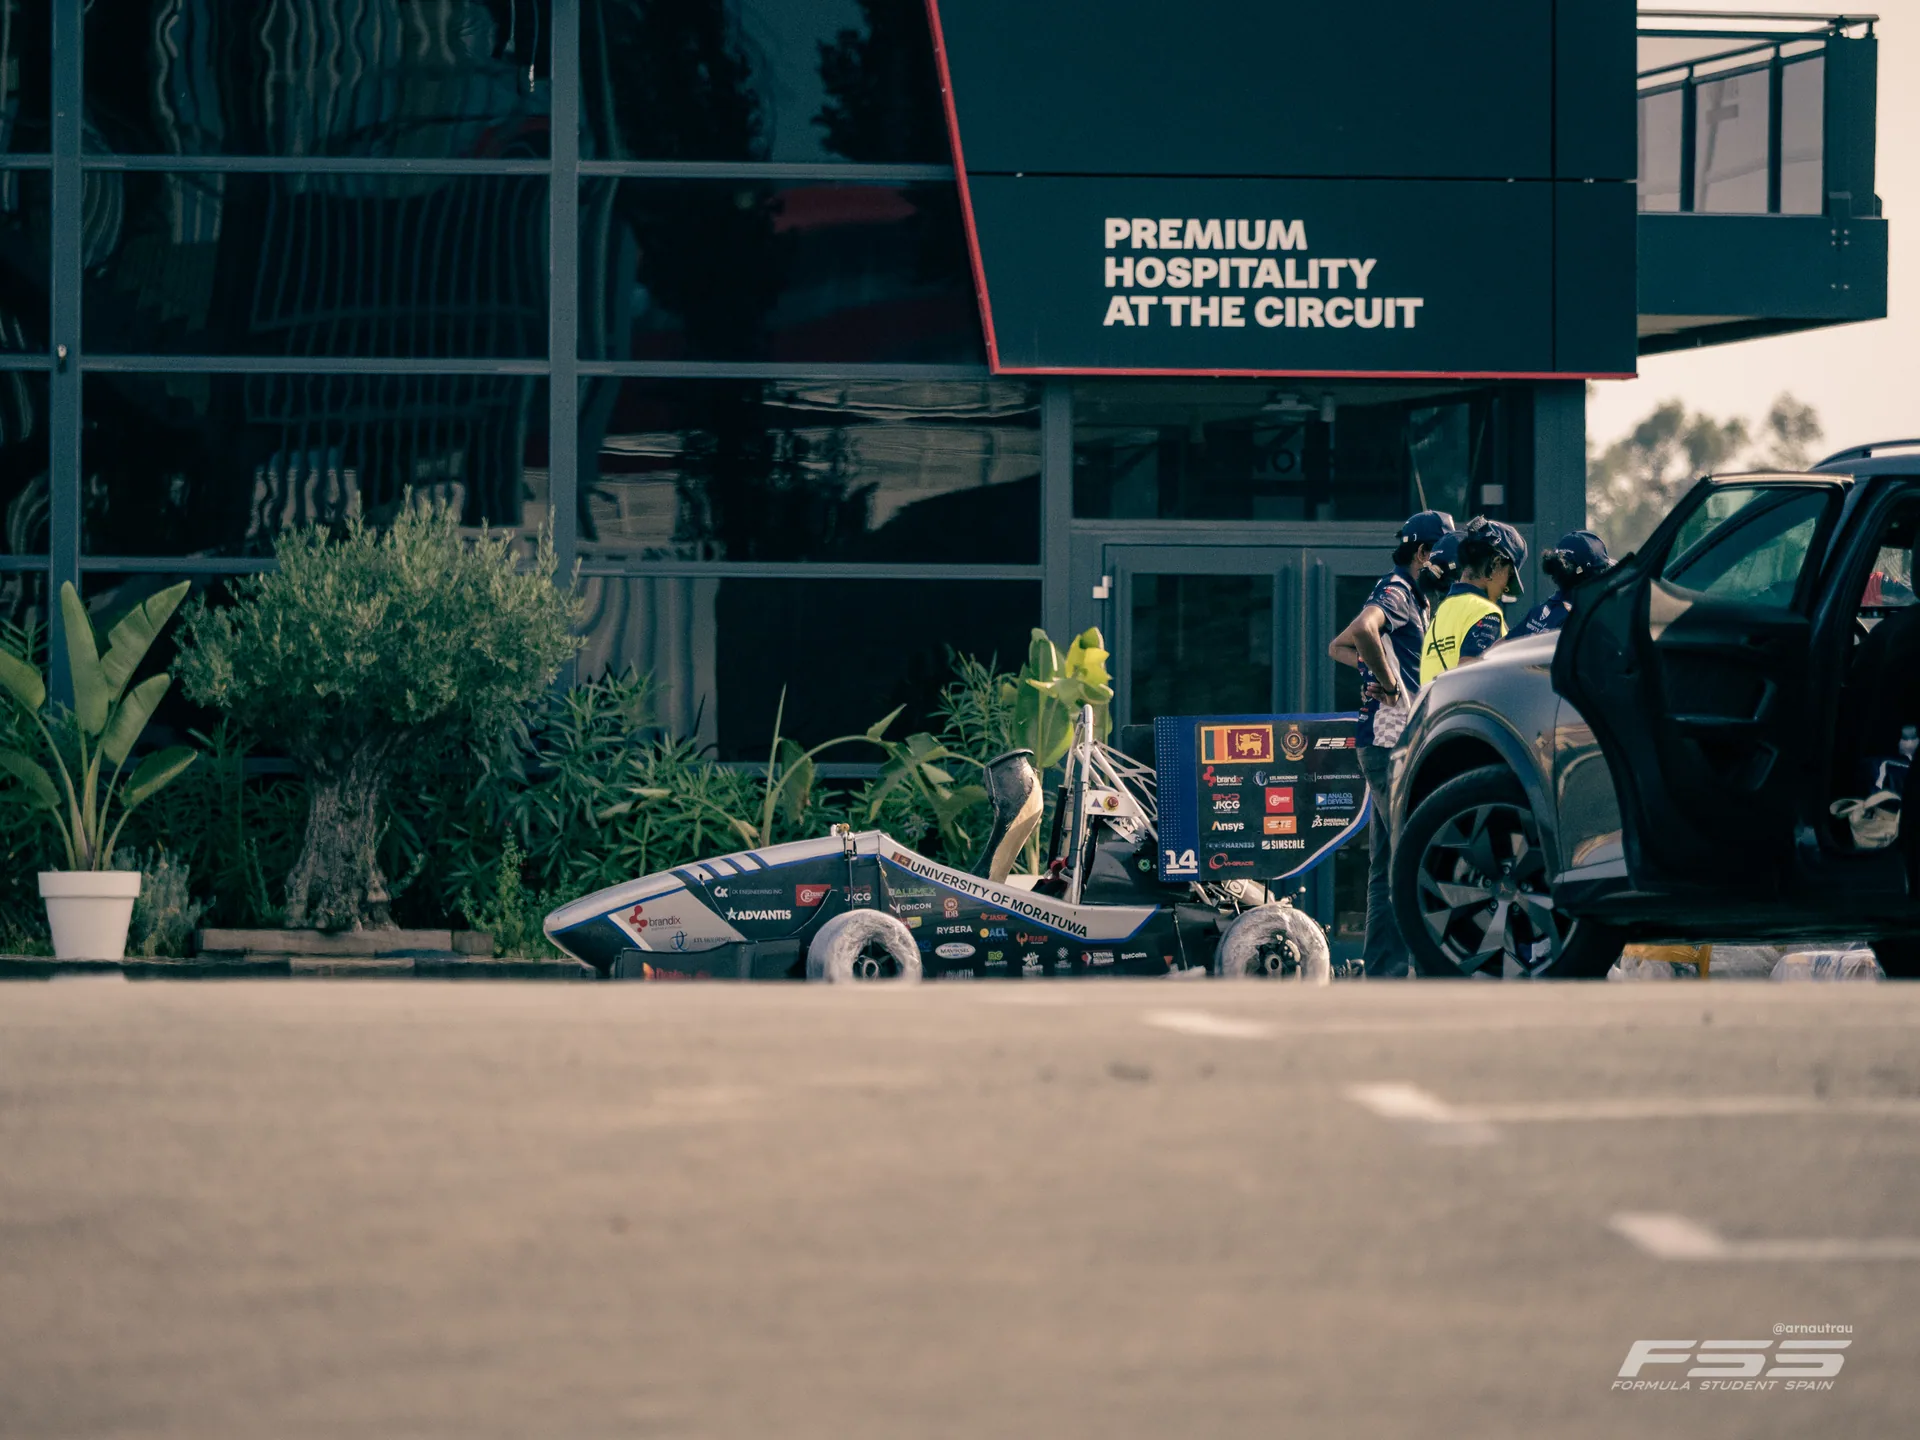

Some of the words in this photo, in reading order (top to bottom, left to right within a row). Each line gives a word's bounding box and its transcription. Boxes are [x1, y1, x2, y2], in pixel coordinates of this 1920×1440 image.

[1104, 218, 1308, 250] PREMIUM
[1104, 256, 1377, 289] HOSPITALITY
[1103, 296, 1158, 326] AT
[1162, 296, 1246, 327] THE
[1254, 297, 1424, 328] CIRCUIT
[1213, 801, 1240, 810] JKCG
[1211, 821, 1245, 832] Ansys
[1271, 840, 1305, 849] SIMSCALE
[1165, 850, 1198, 868] 14
[895, 887, 936, 896] ALUMEX
[844, 893, 872, 902] JKCG
[910, 861, 990, 898] UNIVERSITY
[990, 892, 1011, 906] OF
[1010, 898, 1087, 937] MORATUWA
[737, 909, 792, 921] ADVANTIS
[649, 916, 681, 926] brandix
[936, 925, 973, 934] RYSERA
